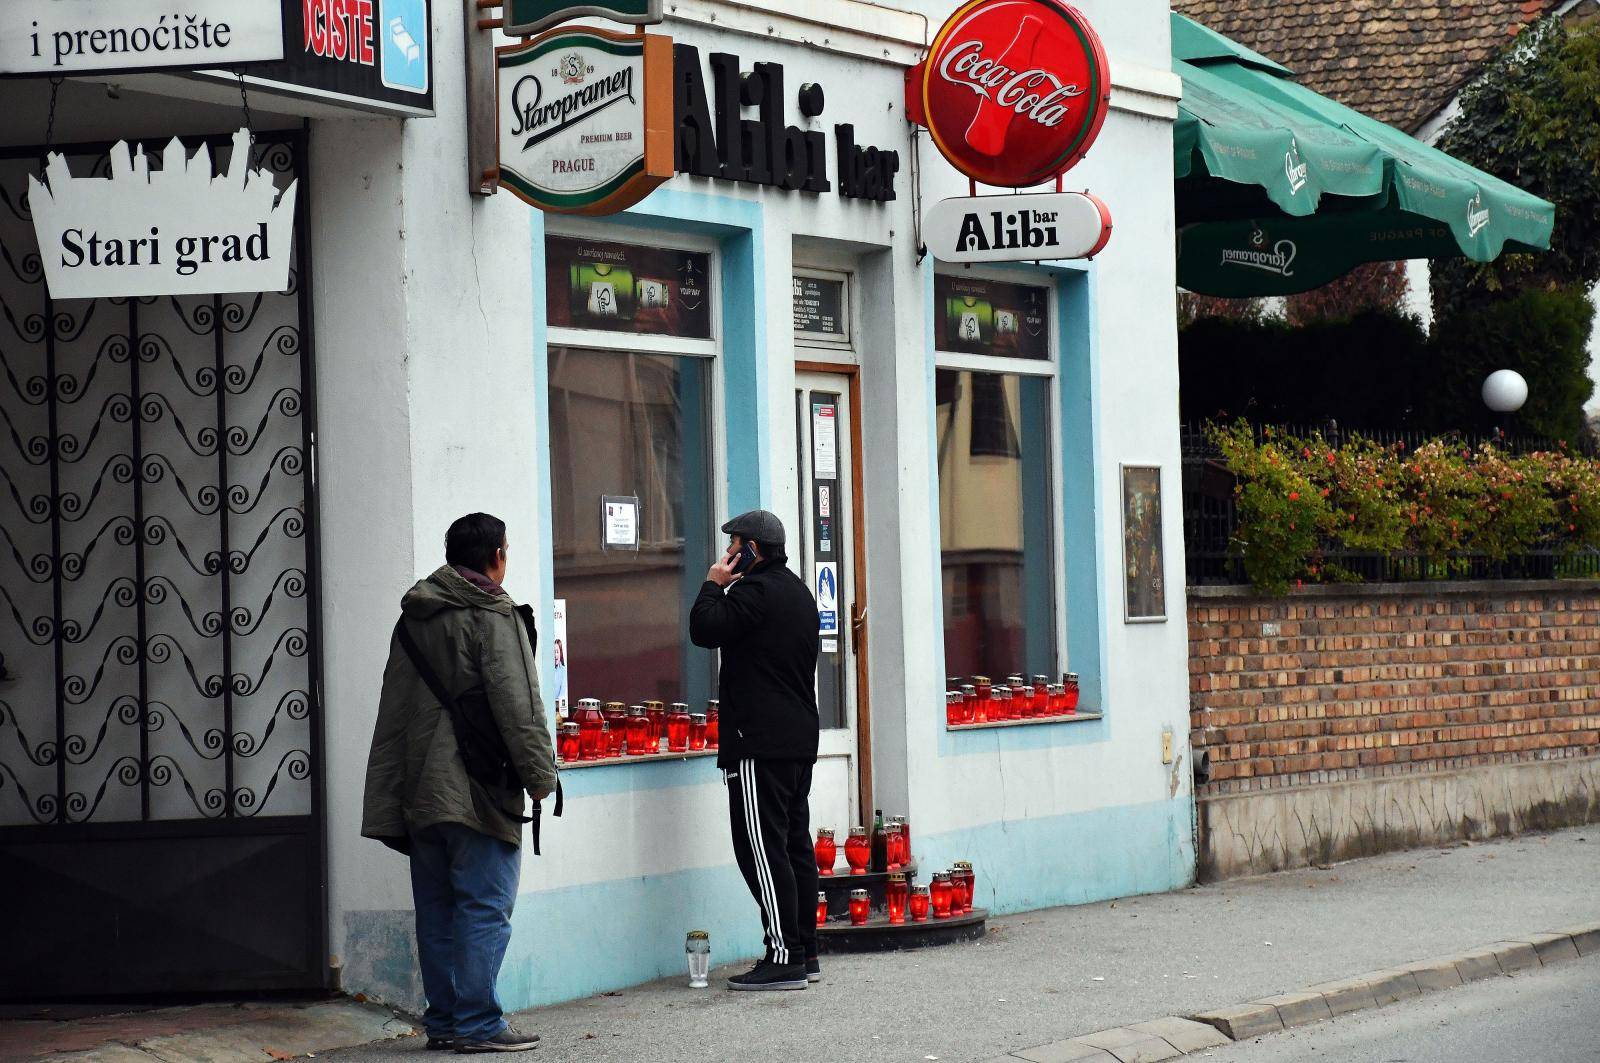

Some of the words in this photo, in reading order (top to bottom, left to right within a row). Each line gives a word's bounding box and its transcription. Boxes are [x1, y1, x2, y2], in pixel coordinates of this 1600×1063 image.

[30, 21, 42, 57] i
[52, 14, 231, 66] prenoćište
[511, 65, 636, 138] Staropramen
[939, 39, 1087, 127] Coca-Cola
[580, 133, 613, 144] PREMIUM
[615, 132, 633, 141] BEER
[673, 43, 831, 192] Alibi
[835, 123, 899, 201] bar
[552, 159, 595, 174] PRAGUE
[61, 226, 161, 268] Stari
[175, 222, 270, 275] grad
[956, 210, 1060, 252] Alibi
[1032, 210, 1058, 223] bar
